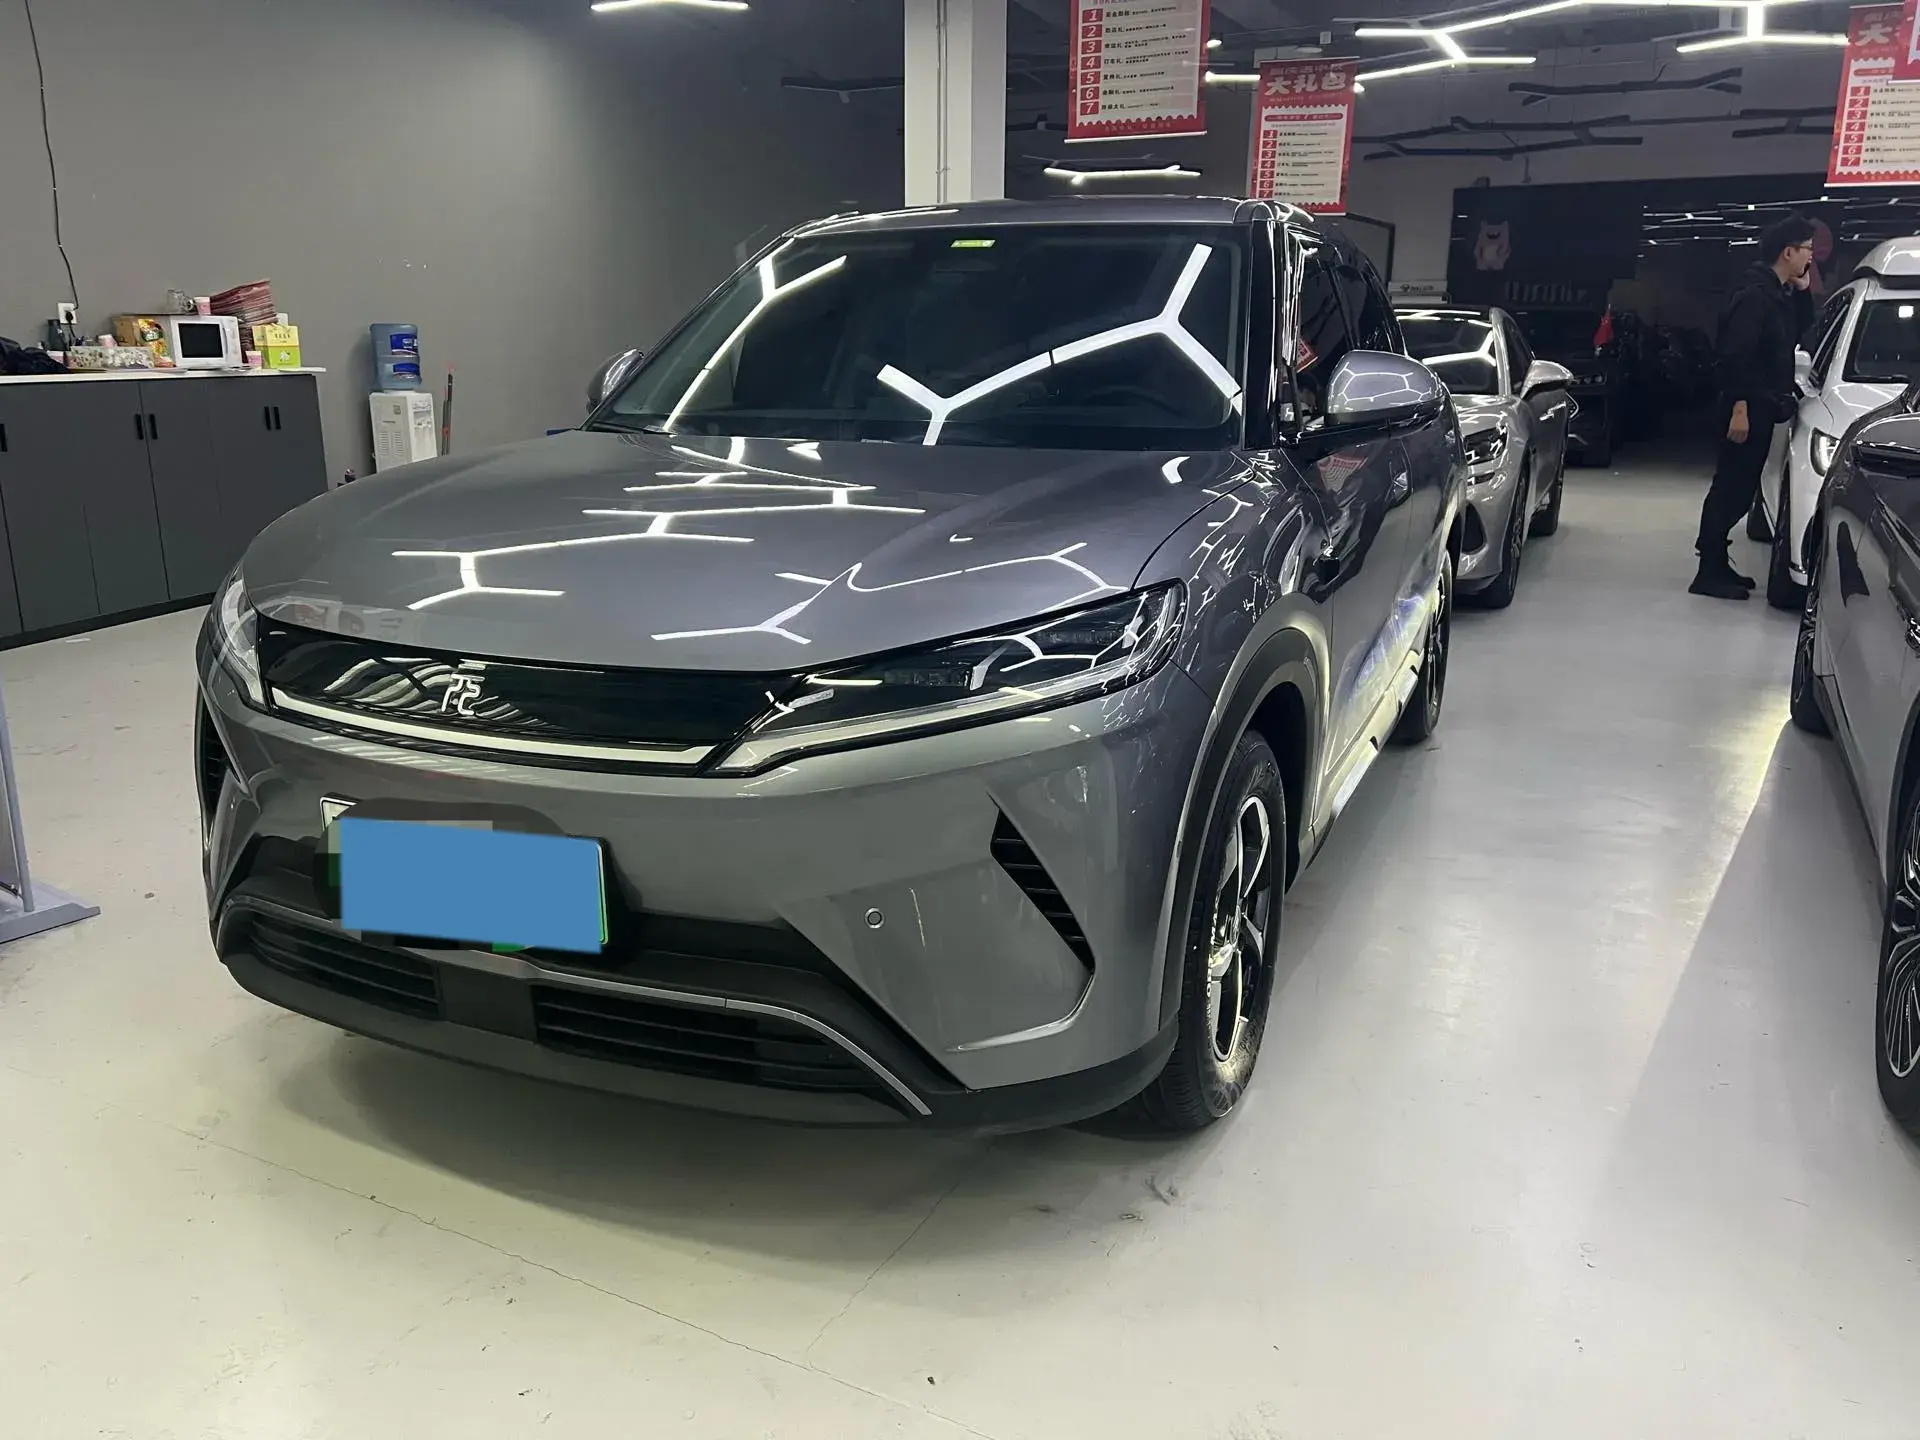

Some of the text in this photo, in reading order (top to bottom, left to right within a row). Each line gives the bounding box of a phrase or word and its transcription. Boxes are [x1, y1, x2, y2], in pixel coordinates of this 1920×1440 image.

[1089, 9, 1097, 21] 1
[1087, 25, 1097, 37] 2
[1086, 41, 1096, 53] 3
[1086, 56, 1095, 68] 4
[1086, 72, 1095, 84] 5
[1264, 72, 1346, 96] 大礼包
[1086, 88, 1094, 99] 6
[1086, 103, 1094, 114] 7
